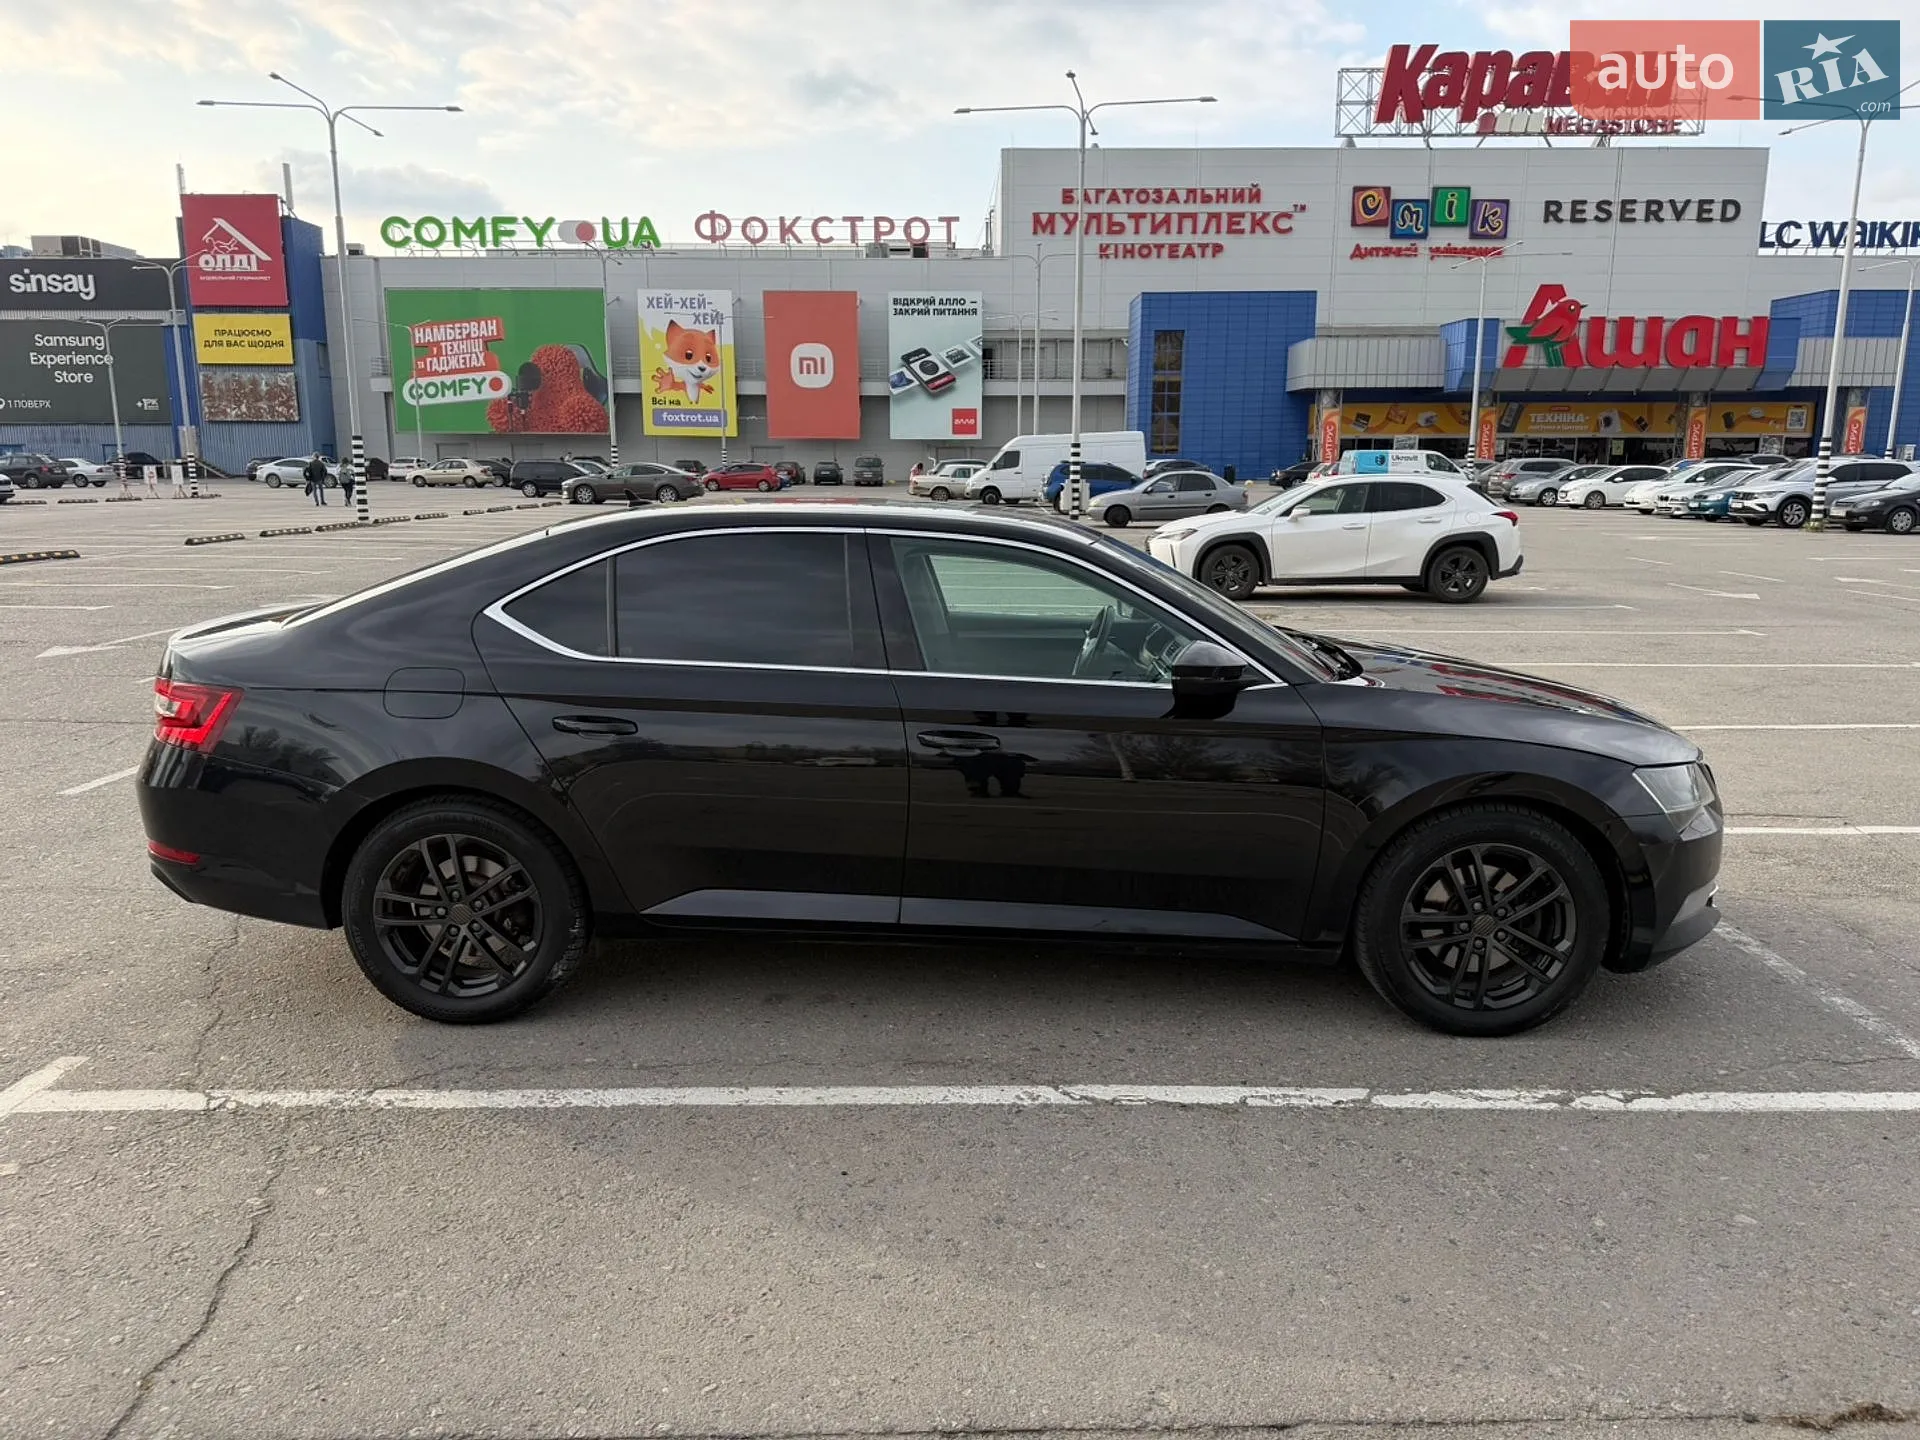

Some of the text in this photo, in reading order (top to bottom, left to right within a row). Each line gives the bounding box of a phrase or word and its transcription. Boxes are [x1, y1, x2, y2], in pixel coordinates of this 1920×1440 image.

[1062, 183, 1262, 205] БАГАТОЗАЛЬНИЙ
[1543, 199, 1741, 223] RESERVED
[694, 210, 960, 245] ФОКСТРОТ
[1032, 212, 1294, 235] МУЛЬТИПЛЕКС
[380, 216, 661, 249] COMFY UA
[1759, 221, 1801, 248] LC
[1099, 243, 1224, 259] КІНОТЕАТР
[9, 268, 96, 300] sinsay
[893, 296, 936, 306] ВІДКРИЙ
[938, 297, 967, 306] АЛЛО
[893, 306, 978, 316] ЗАКРИЙ ПИТАННЯ
[214, 328, 272, 338] ПРАЦЮЄМО
[415, 320, 497, 343] НАМБЕРВАН
[34, 334, 105, 350] Samsung
[203, 340, 285, 349] ДЛЯ ВАС ЩОДНЯ
[30, 352, 113, 368] Experience
[55, 370, 93, 383] Store
[408, 376, 487, 400] COMFY
[14, 399, 51, 409] ПОВЕРХ
[652, 396, 667, 406] Всі
[662, 411, 719, 423] foxtrot.ua
